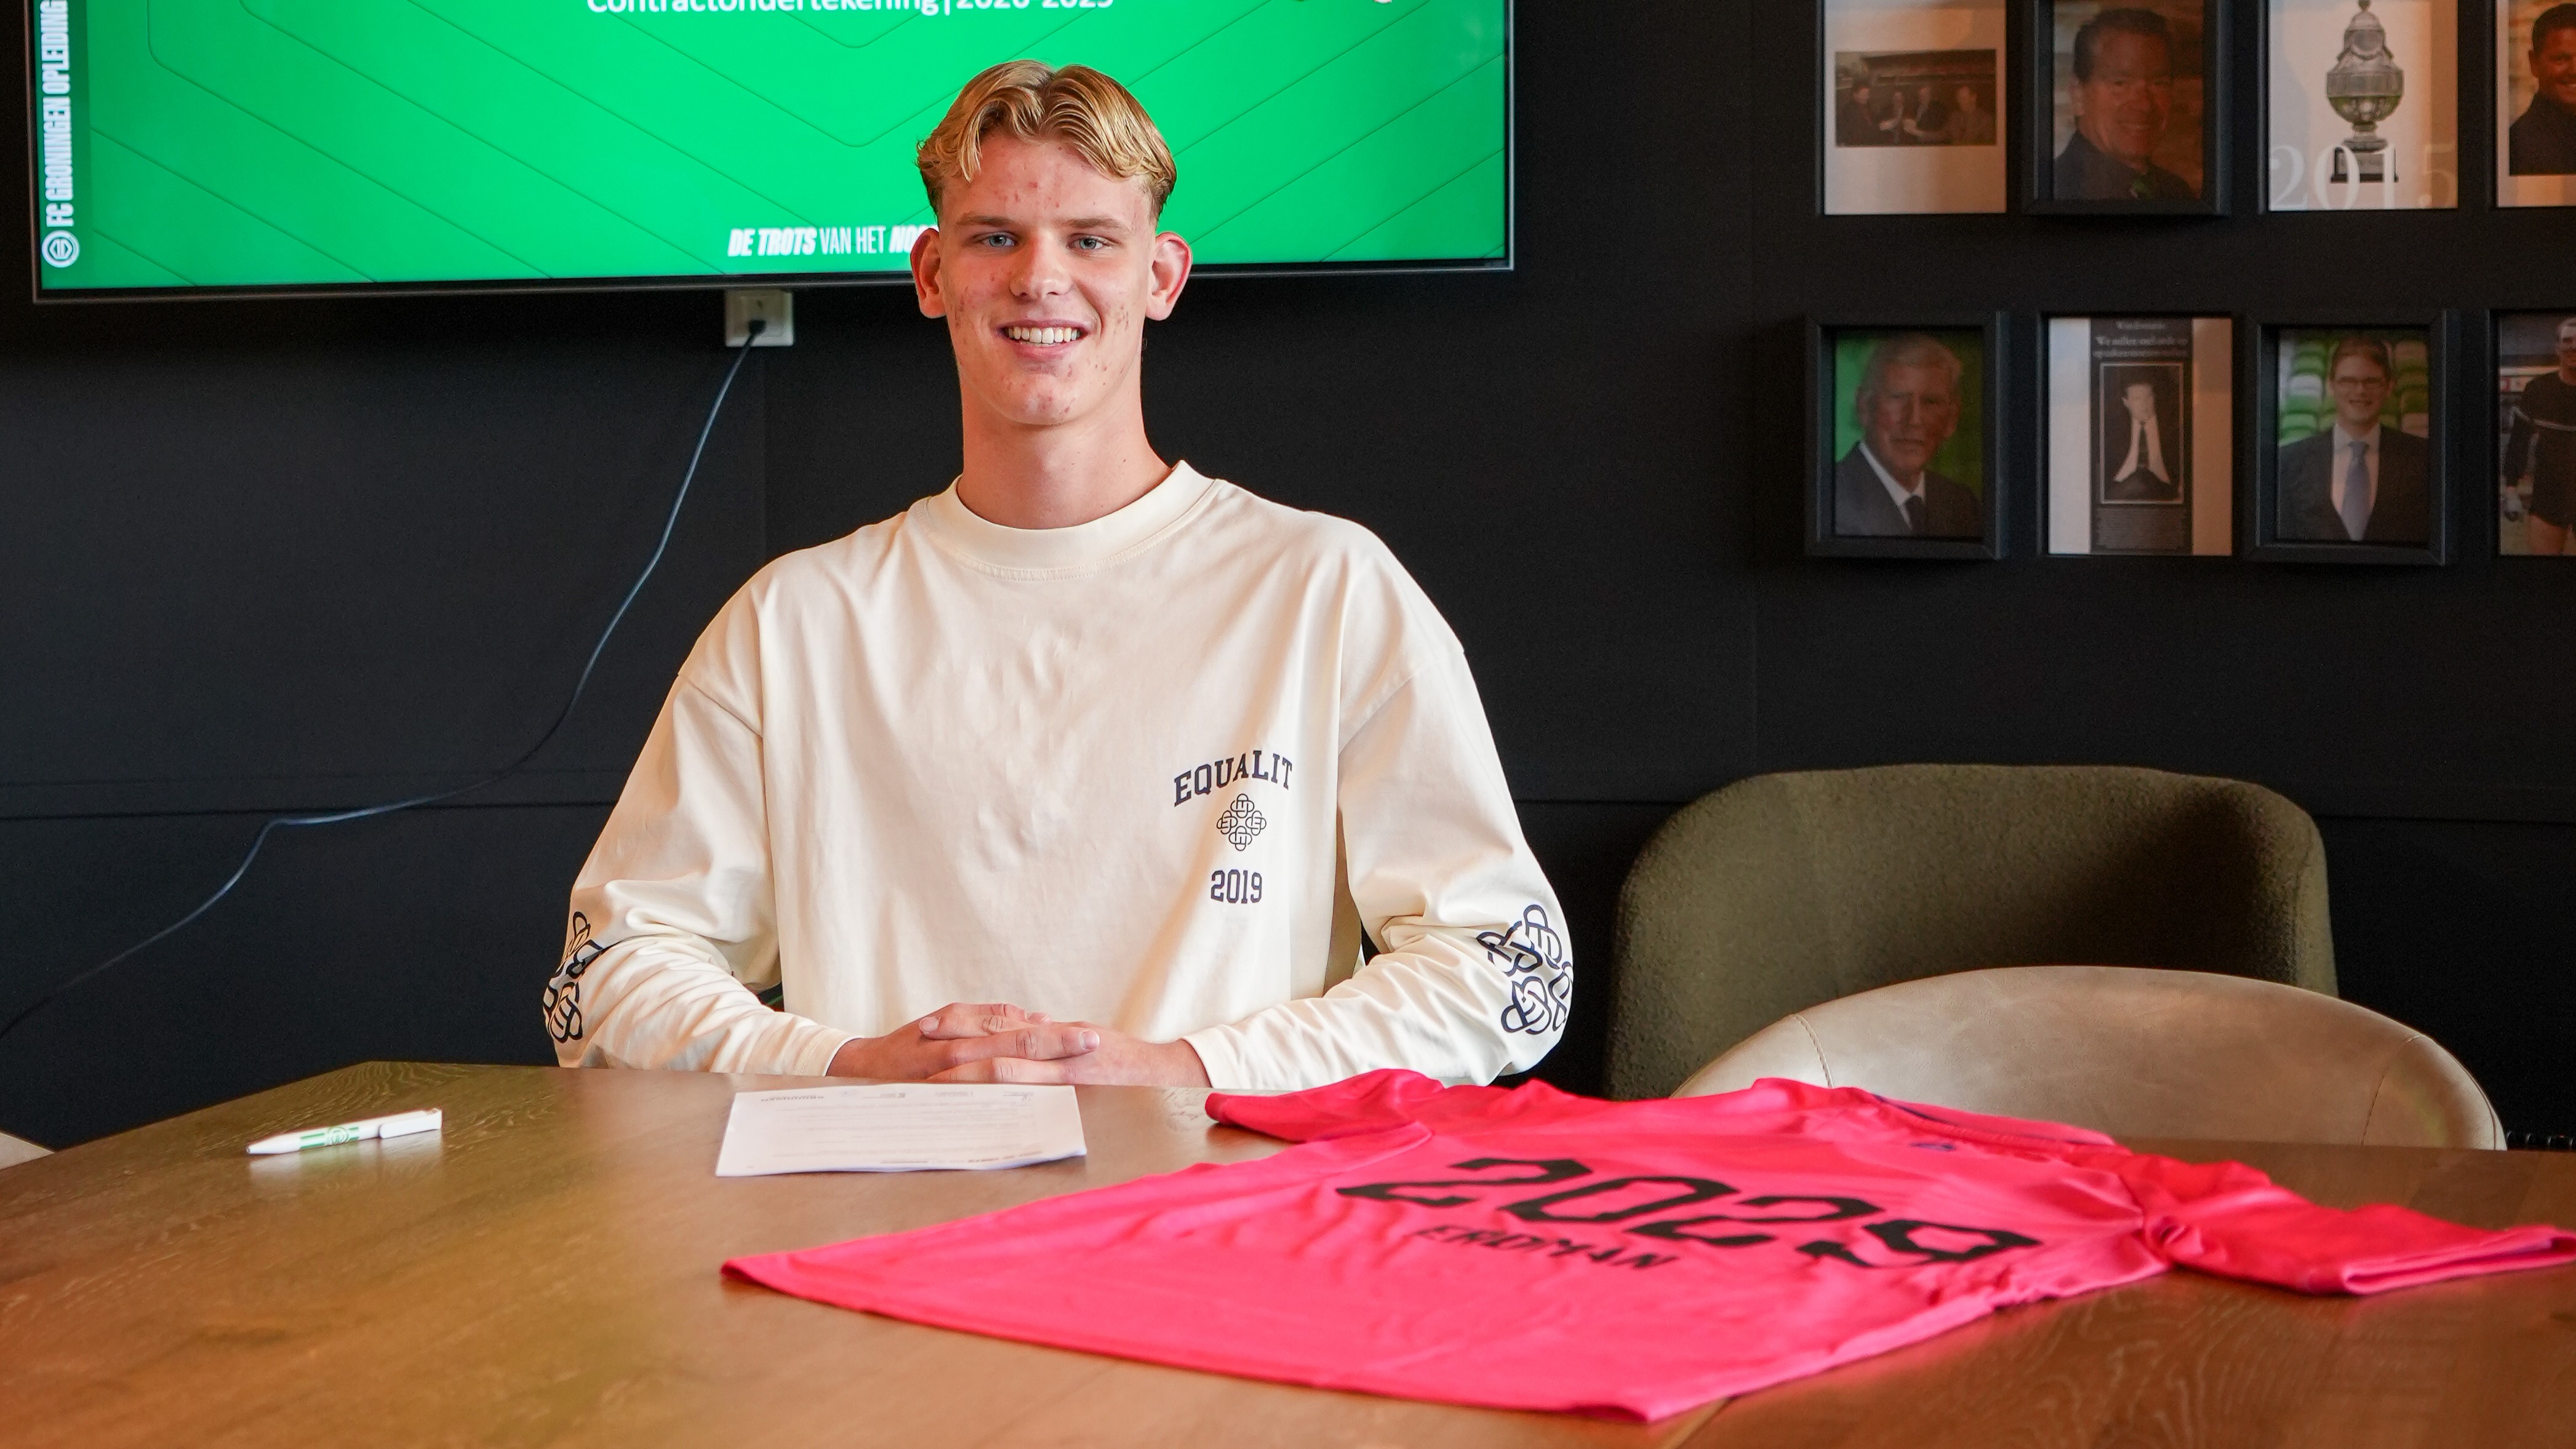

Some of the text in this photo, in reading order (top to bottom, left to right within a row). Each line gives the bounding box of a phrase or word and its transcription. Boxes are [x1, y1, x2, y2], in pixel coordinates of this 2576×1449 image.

[40, 0, 74, 227] FC GRONINGEN OPLEIDING
[2269, 143, 2458, 210] 2015
[727, 228, 756, 257] DE
[758, 226, 818, 256] TROTS
[819, 226, 852, 255] VAN
[855, 226, 887, 254] HET
[1210, 869, 1263, 904] 2019
[1335, 1157, 2044, 1267] 2029
[1417, 1224, 1680, 1270] ERDMAN
